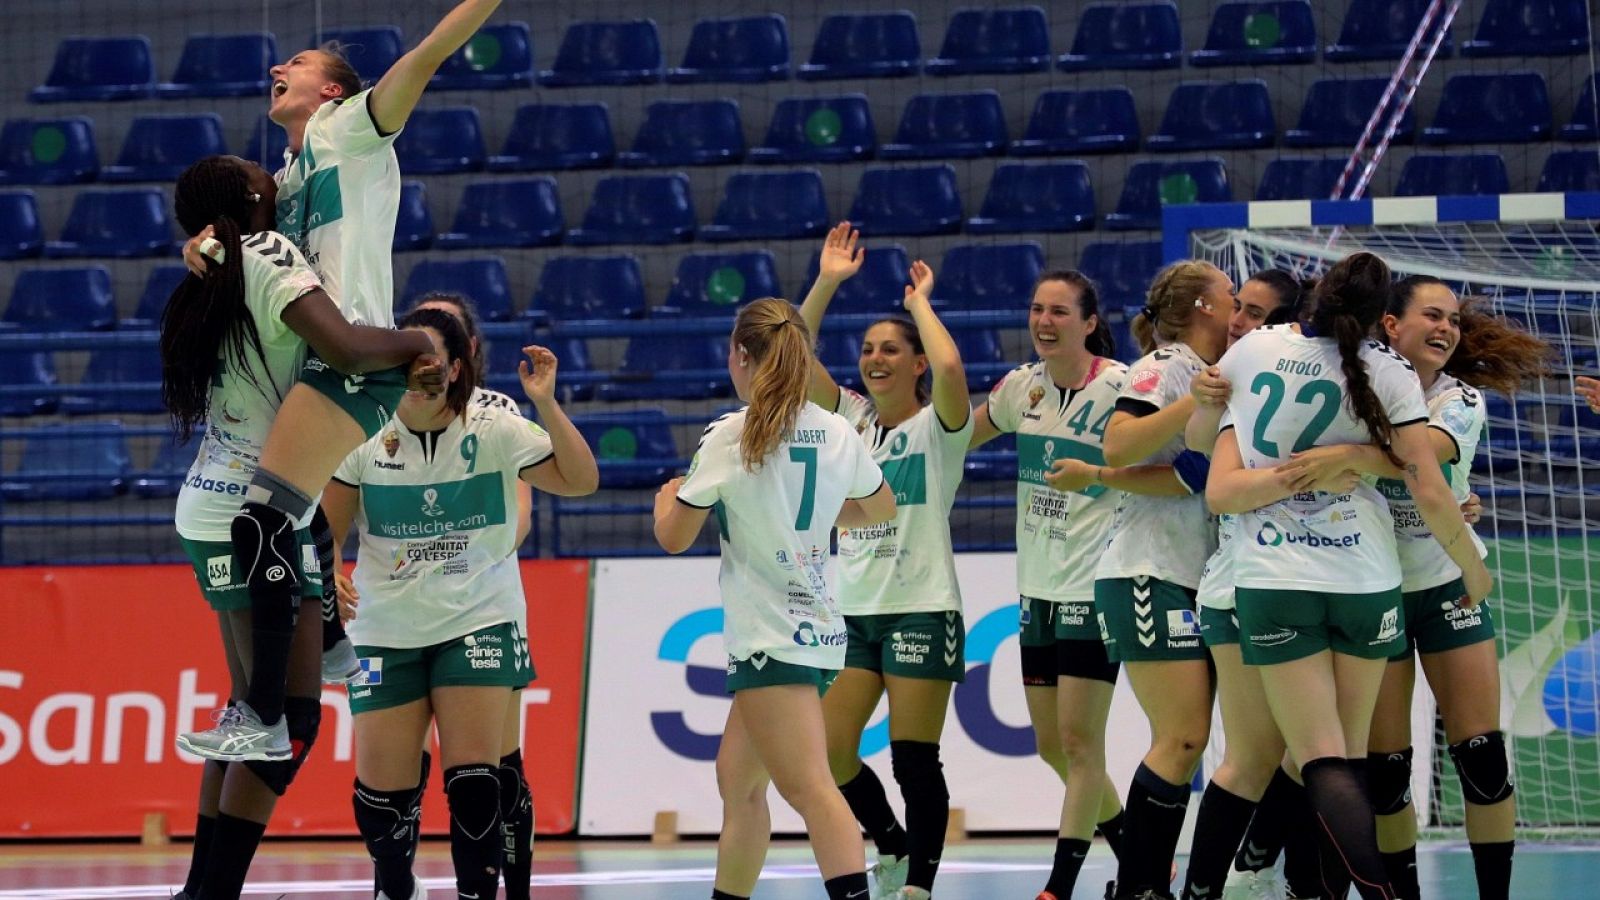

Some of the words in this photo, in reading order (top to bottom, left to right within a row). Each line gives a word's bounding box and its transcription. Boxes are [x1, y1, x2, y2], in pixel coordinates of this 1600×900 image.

[1276, 358, 1322, 377] BITOLO
[1250, 371, 1342, 459] 22
[460, 432, 478, 474] 9
[789, 447, 818, 531] 7
[1451, 614, 1482, 630] tesla
[470, 656, 501, 669] tesla
[895, 651, 924, 664] tesla
